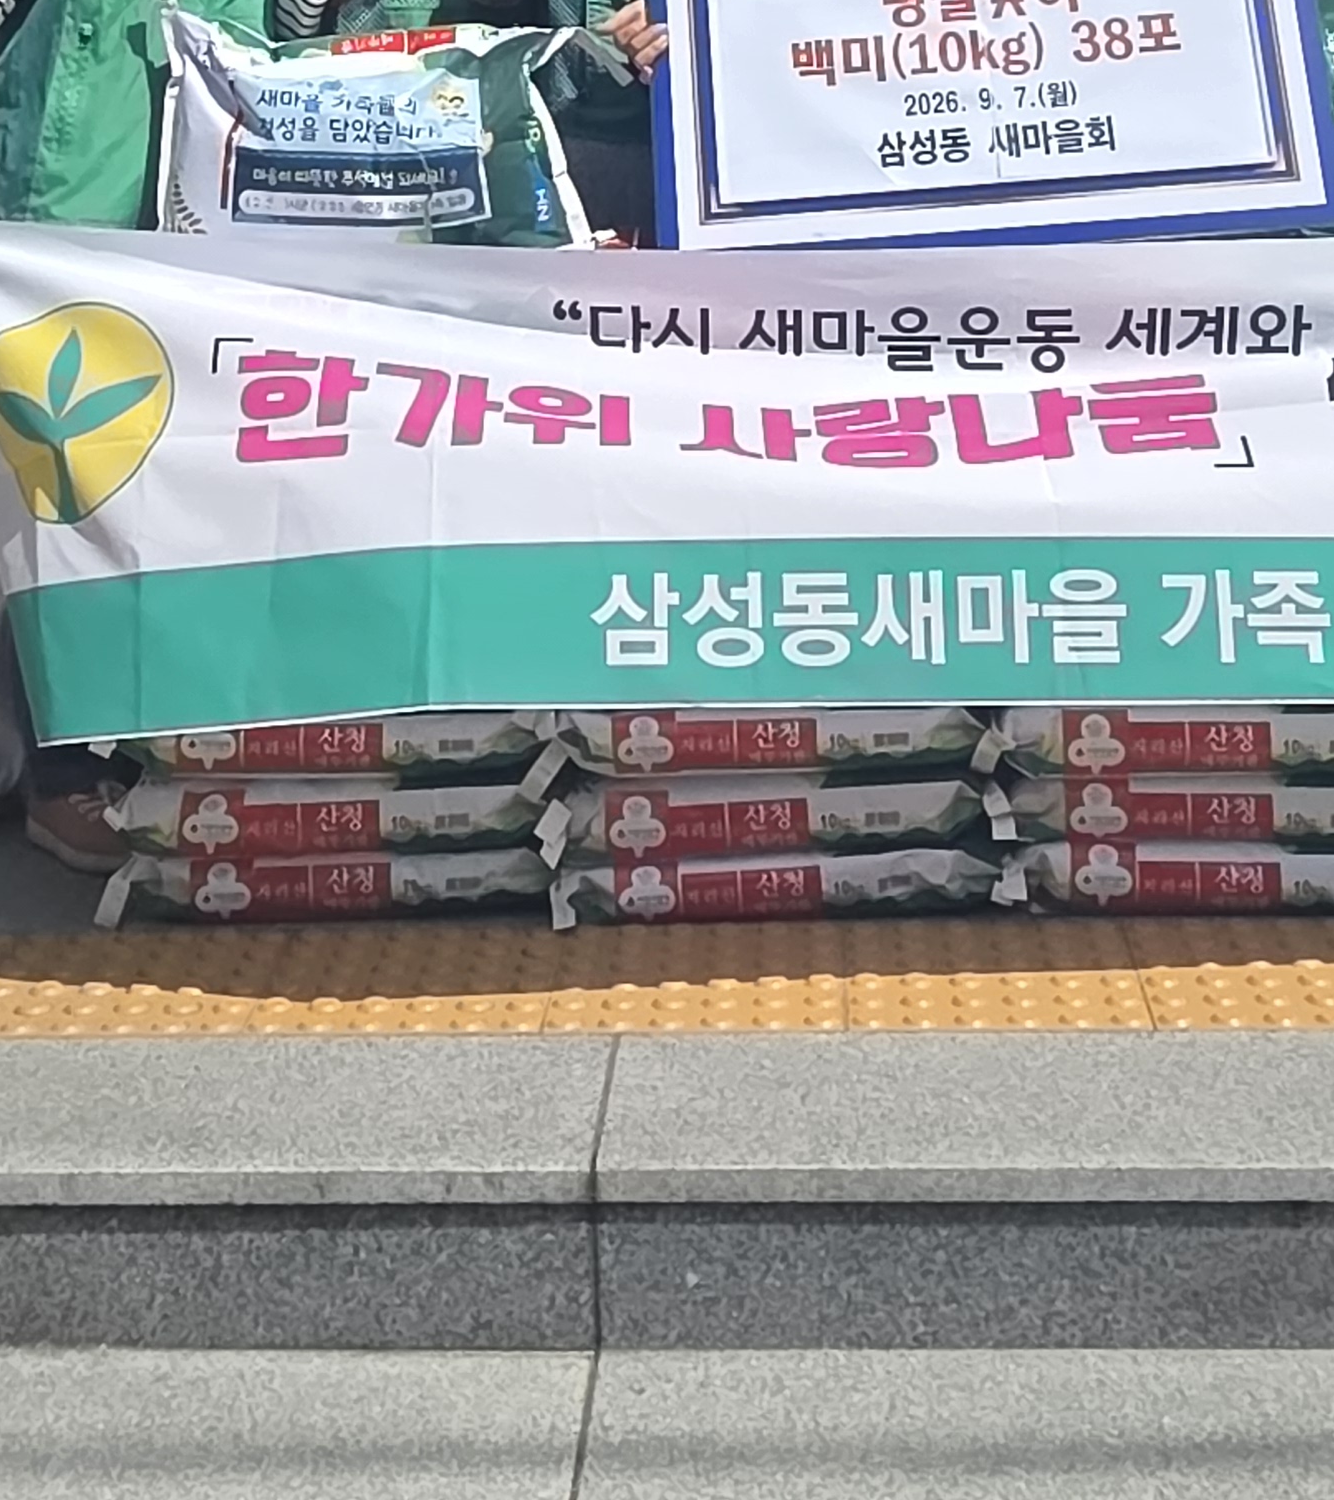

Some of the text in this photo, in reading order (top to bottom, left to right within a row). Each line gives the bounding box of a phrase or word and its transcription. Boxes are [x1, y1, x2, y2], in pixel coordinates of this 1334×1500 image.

[790, 12, 1183, 87] 백미(10kg) 38포
[256, 89, 323, 113] 새마을
[904, 91, 968, 117] 2026.
[978, 86, 1002, 112] 9.
[877, 116, 1118, 169] 삼성동 새마을회
[552, 300, 712, 357] “다시
[737, 303, 1081, 373] 새마을운동
[1104, 300, 1313, 358] 세계와
[590, 569, 1128, 668] 삼성동새마을
[1161, 568, 1331, 666] 가족
